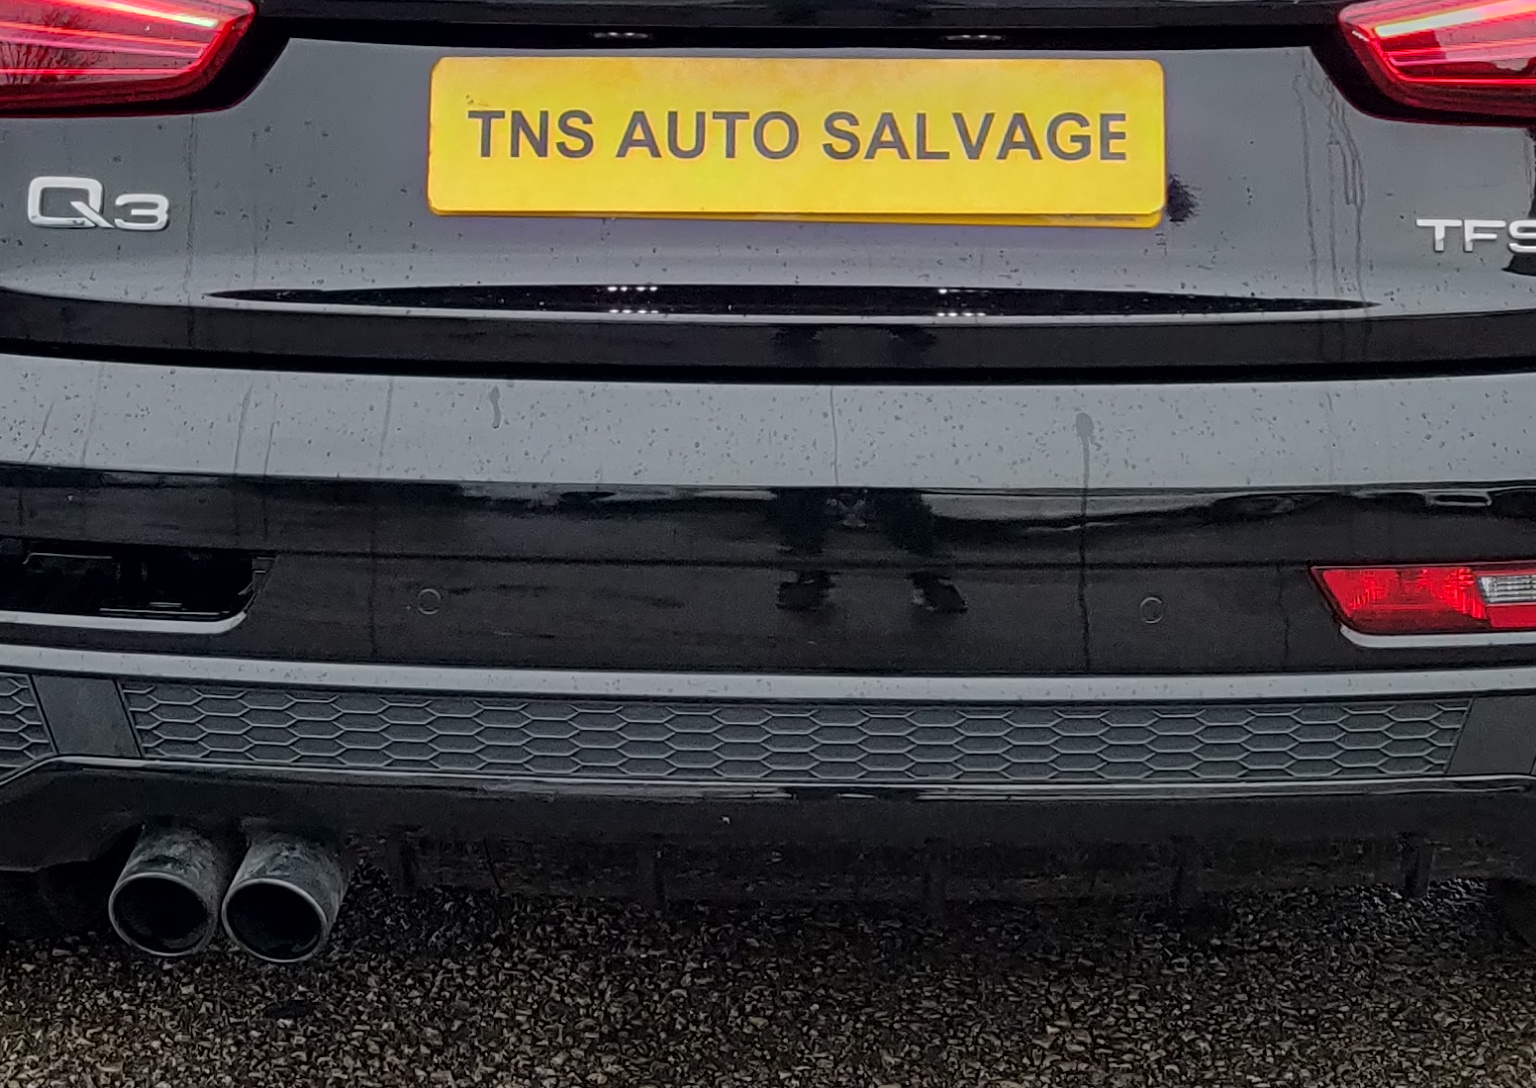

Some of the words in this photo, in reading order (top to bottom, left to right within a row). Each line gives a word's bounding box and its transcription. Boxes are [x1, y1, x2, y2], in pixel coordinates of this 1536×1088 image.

[467, 109, 594, 159] TNS
[616, 109, 799, 160] AUTO
[822, 110, 1127, 161] SALVAGE
[27, 175, 170, 231] Q3
